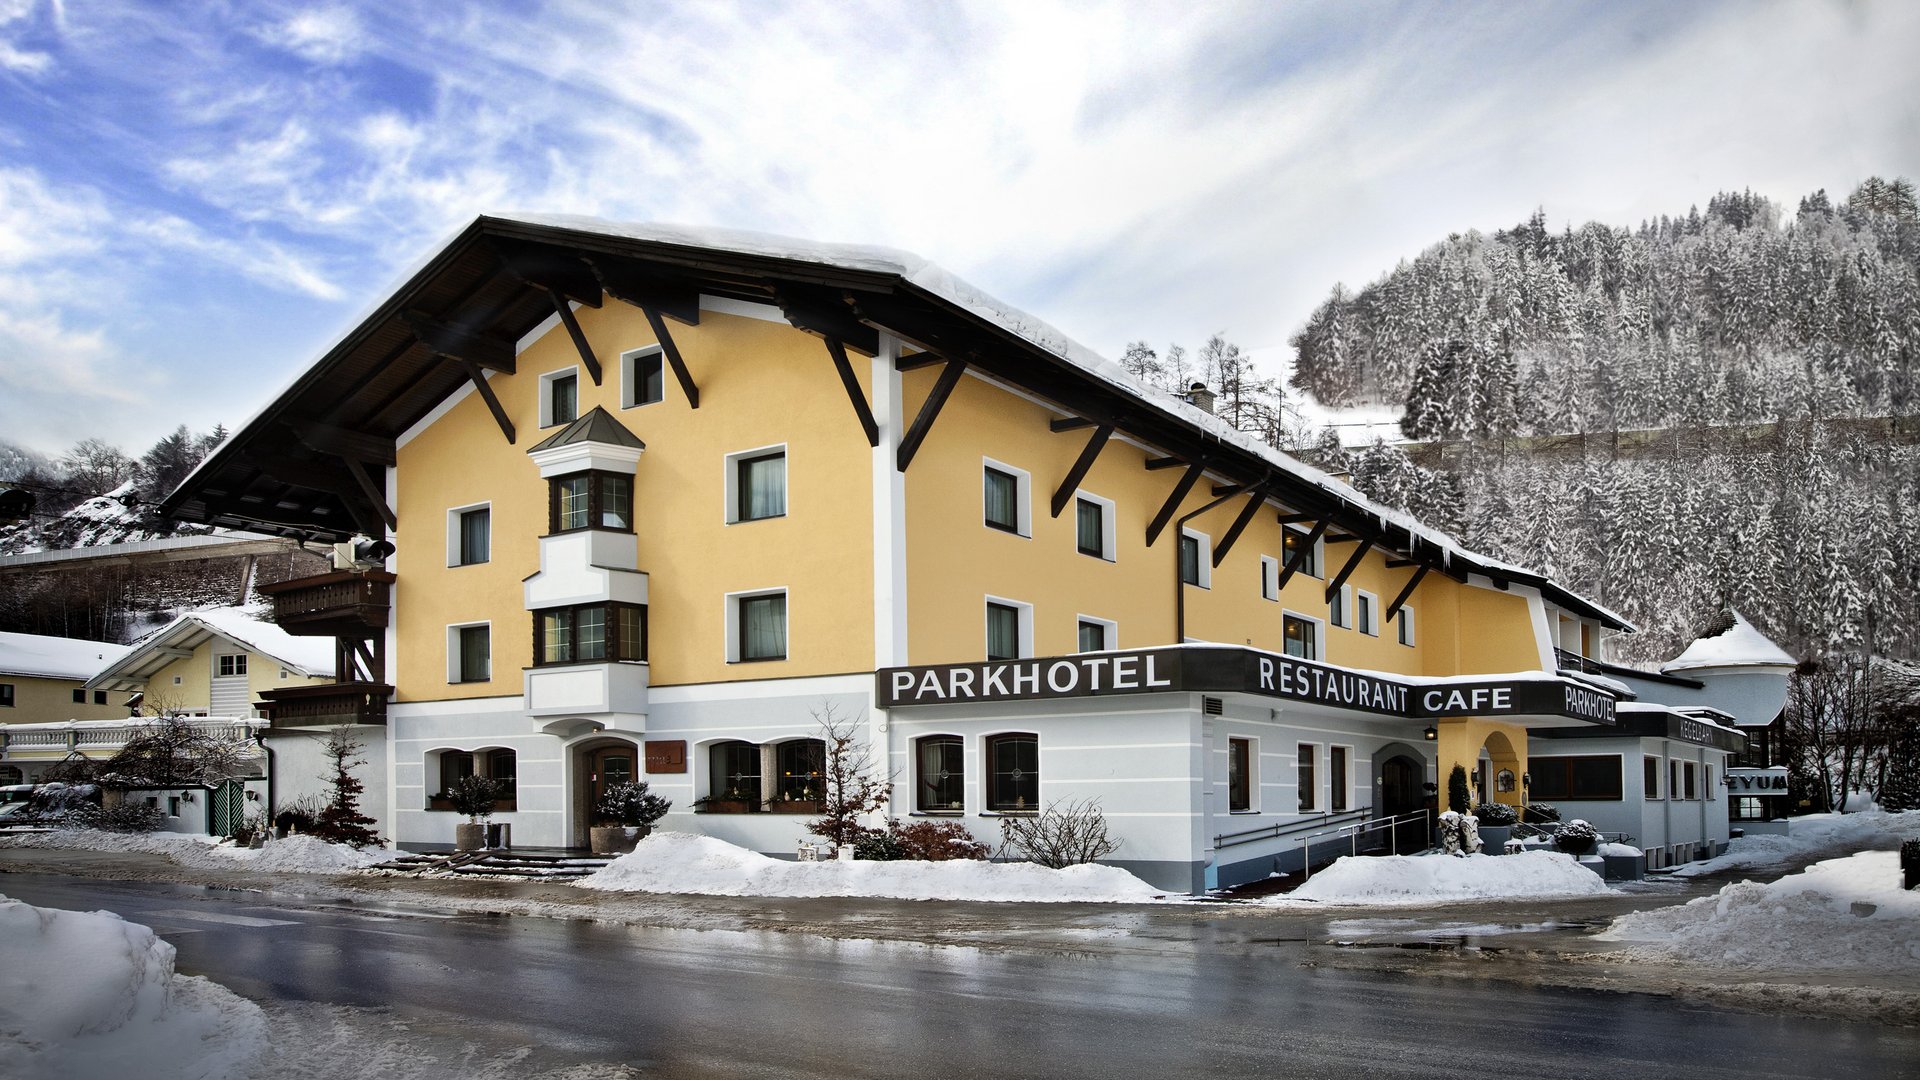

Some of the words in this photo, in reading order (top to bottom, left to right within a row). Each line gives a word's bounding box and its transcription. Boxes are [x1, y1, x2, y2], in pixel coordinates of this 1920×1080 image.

[892, 655, 1170, 700] PARKHOTEL
[1259, 657, 1408, 712] RESTAURANT
[1423, 687, 1512, 711] CAFE
[1565, 686, 1616, 721] PARKHOTEL
